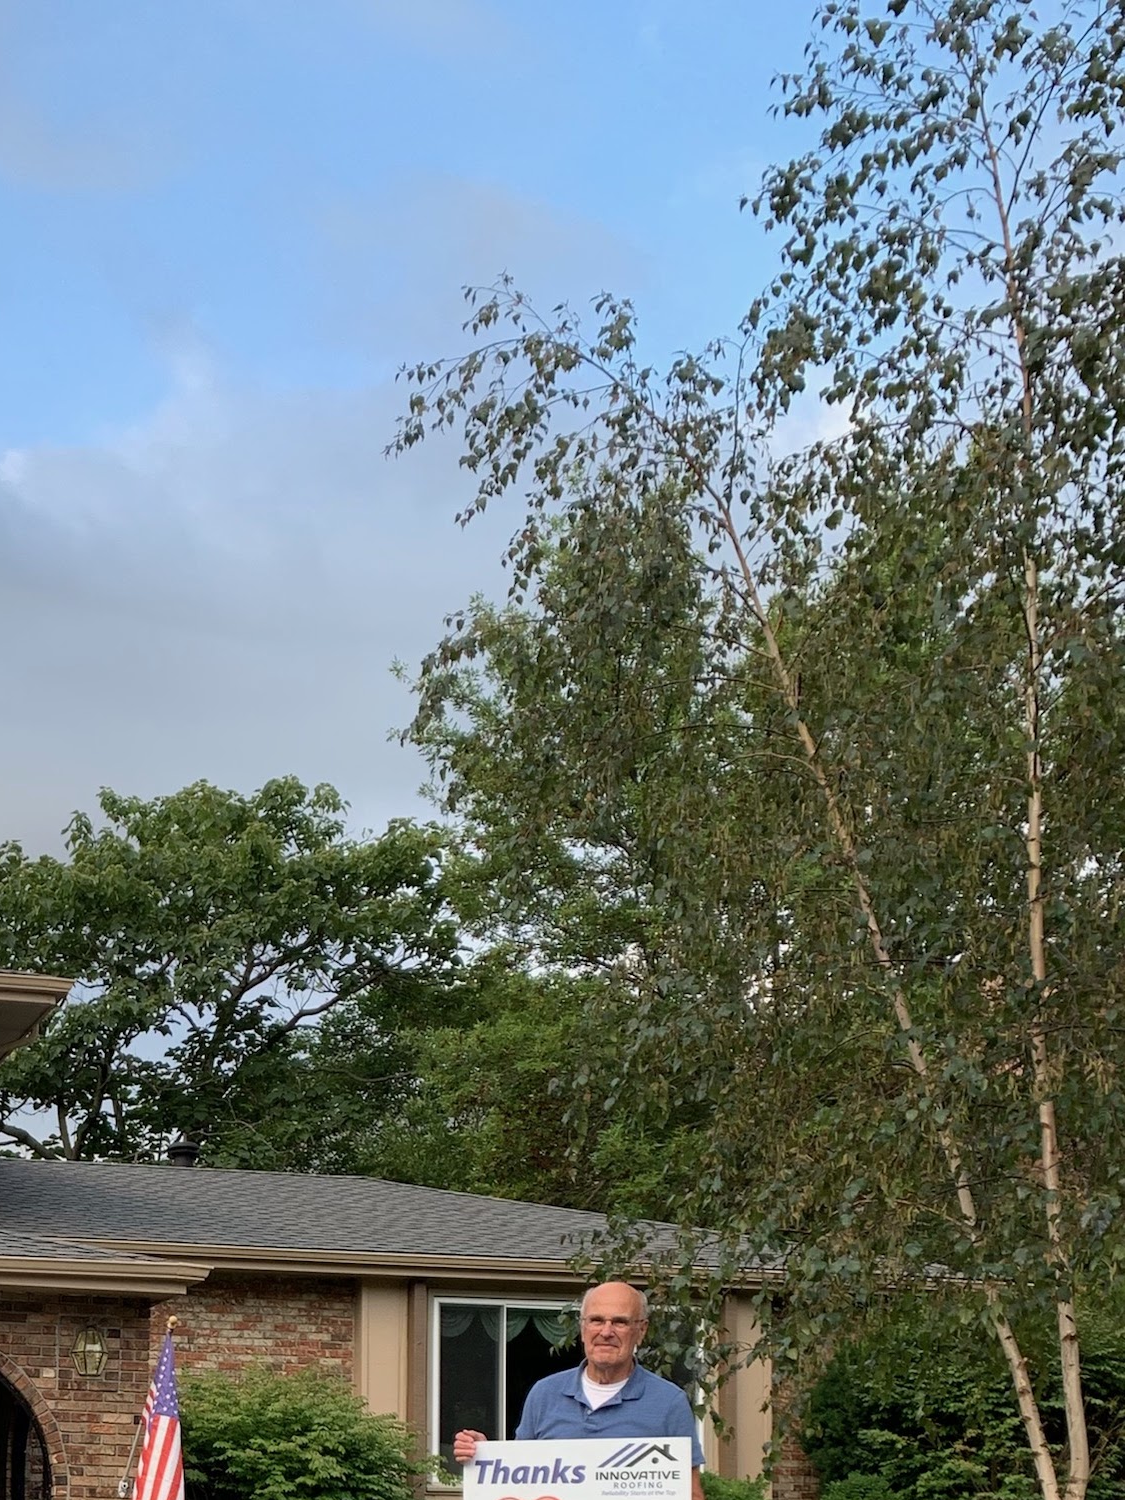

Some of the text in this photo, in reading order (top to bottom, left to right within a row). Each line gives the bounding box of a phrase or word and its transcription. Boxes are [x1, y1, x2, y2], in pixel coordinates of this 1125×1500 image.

[475, 1458, 586, 1484] Thanks
[595, 1470, 681, 1480] INNOVATIVE
[613, 1481, 663, 1489] ROOFING
